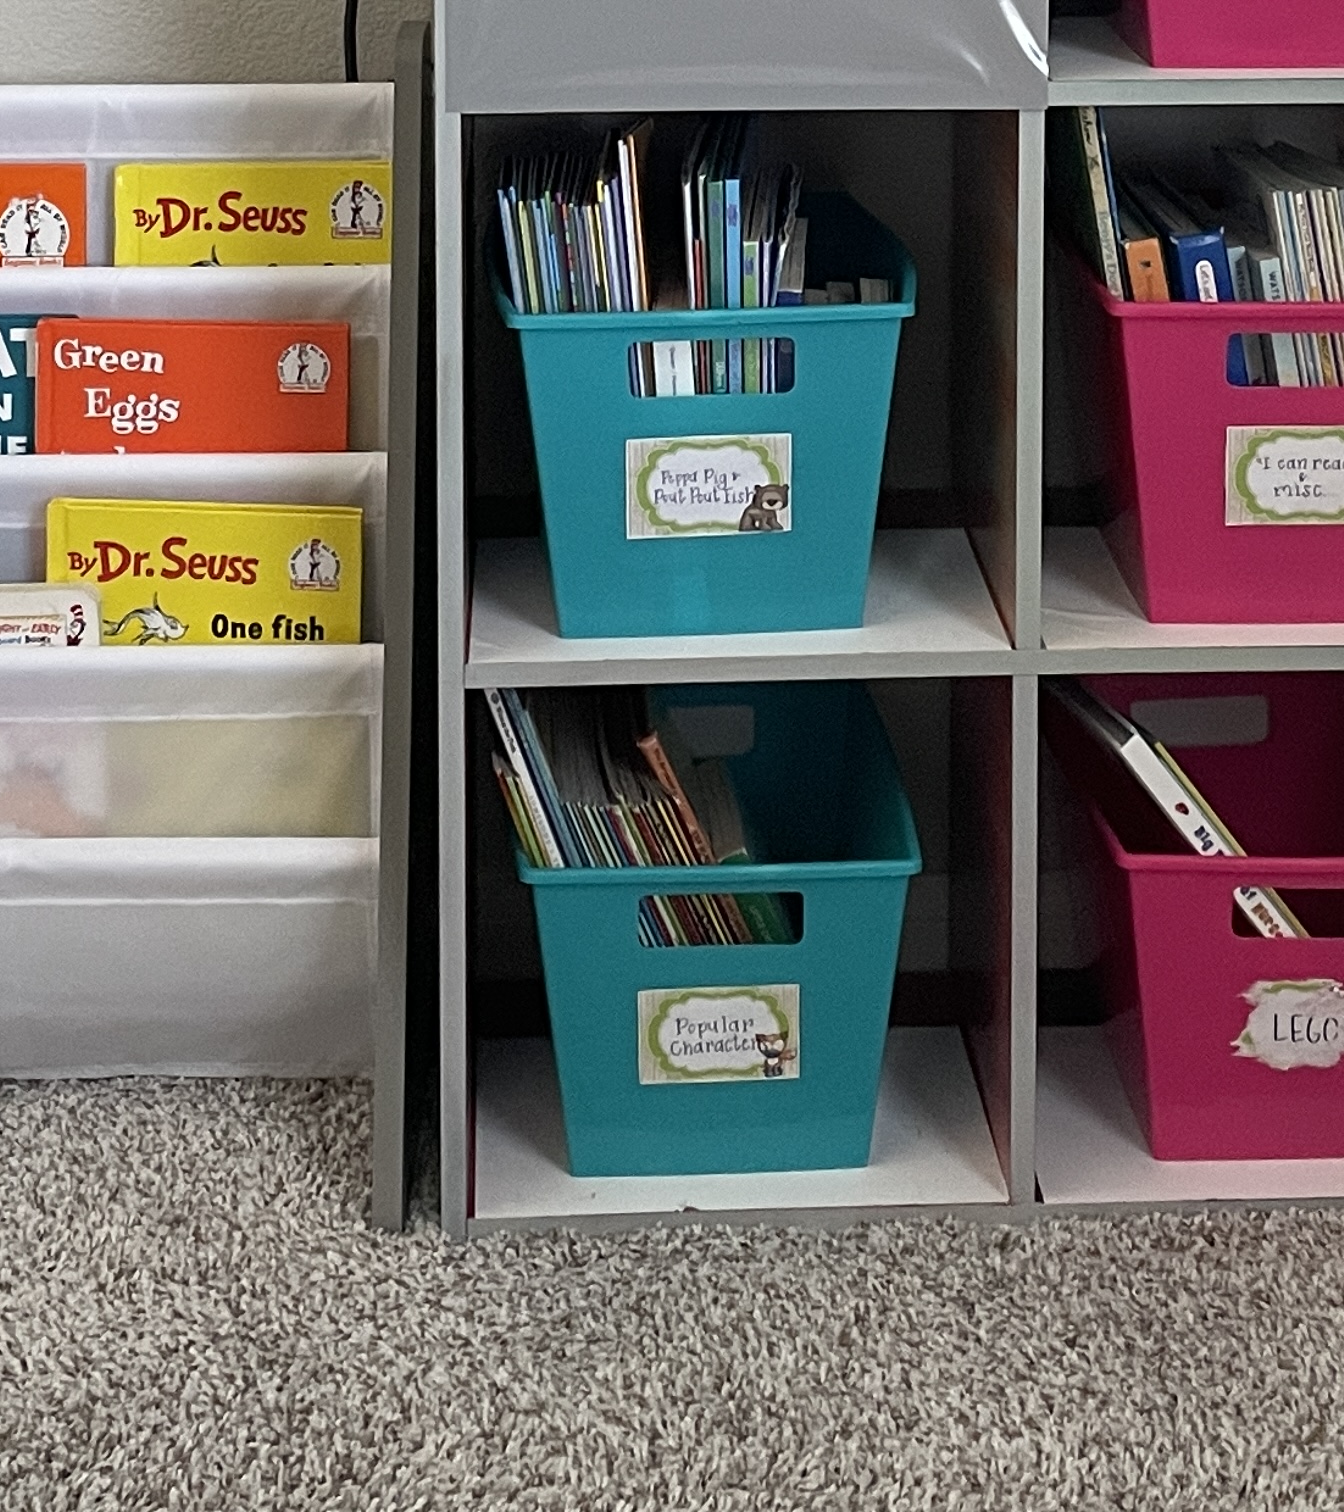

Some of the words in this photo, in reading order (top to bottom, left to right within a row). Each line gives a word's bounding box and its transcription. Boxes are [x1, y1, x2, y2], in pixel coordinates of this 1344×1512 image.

[134, 207, 162, 234] By
[157, 196, 213, 238] Dr.
[218, 191, 308, 236] Seuss
[53, 338, 165, 374] Green
[83, 388, 180, 434] Eggs
[1277, 457, 1307, 470] can
[661, 469, 698, 487] Peppa
[704, 468, 728, 489] Pig
[654, 488, 687, 505] Pout
[690, 487, 721, 504] Pout
[67, 552, 94, 577] By
[93, 541, 155, 583] Dr.
[160, 537, 259, 586] Seuss
[211, 614, 262, 640] One
[271, 613, 325, 641] fish
[676, 1015, 754, 1038] Popular
[1273, 1013, 1339, 1044] LEGO
